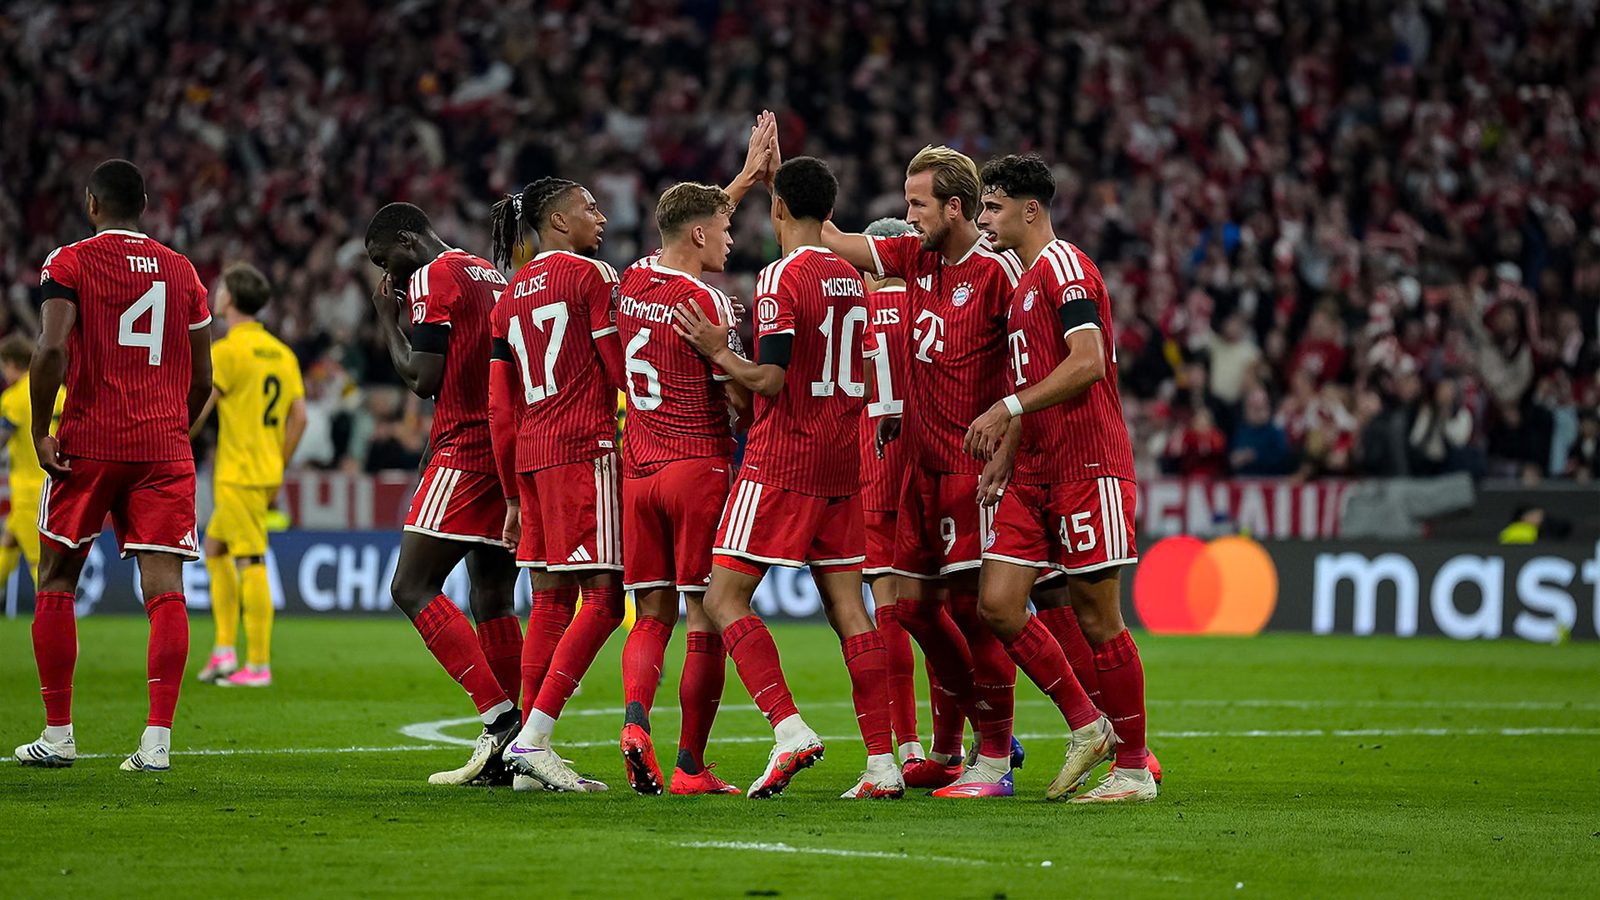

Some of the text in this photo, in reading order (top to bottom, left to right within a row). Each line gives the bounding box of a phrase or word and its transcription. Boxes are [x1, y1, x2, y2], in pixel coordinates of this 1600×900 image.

[126, 255, 159, 274] TAH
[514, 271, 549, 299] OLISE
[820, 277, 865, 299] MUSIALA
[118, 280, 166, 366] 4
[619, 294, 676, 325] KIMMICH
[507, 301, 570, 406] 17
[625, 327, 663, 411] 6
[810, 305, 869, 398] 10
[262, 374, 281, 427] 2
[939, 516, 956, 555] 9
[1059, 511, 1097, 553] 45
